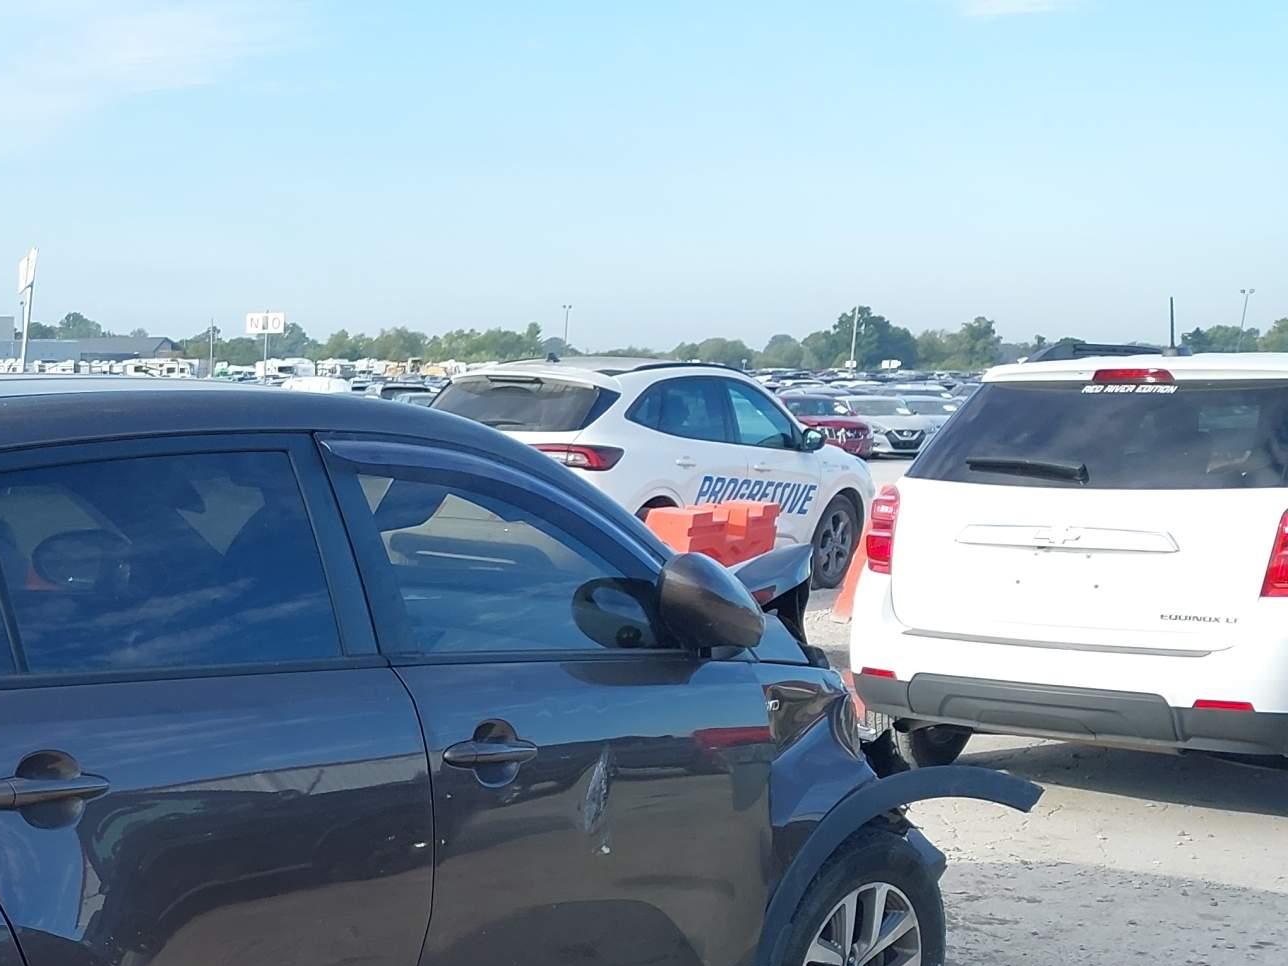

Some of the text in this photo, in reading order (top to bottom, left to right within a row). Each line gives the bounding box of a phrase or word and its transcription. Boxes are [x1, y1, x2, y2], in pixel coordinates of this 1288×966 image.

[1081, 384, 1179, 394] RED RIVER EDITION
[695, 475, 817, 515] PROGRESSIVE
[1159, 613, 1221, 624] EQUINOX
